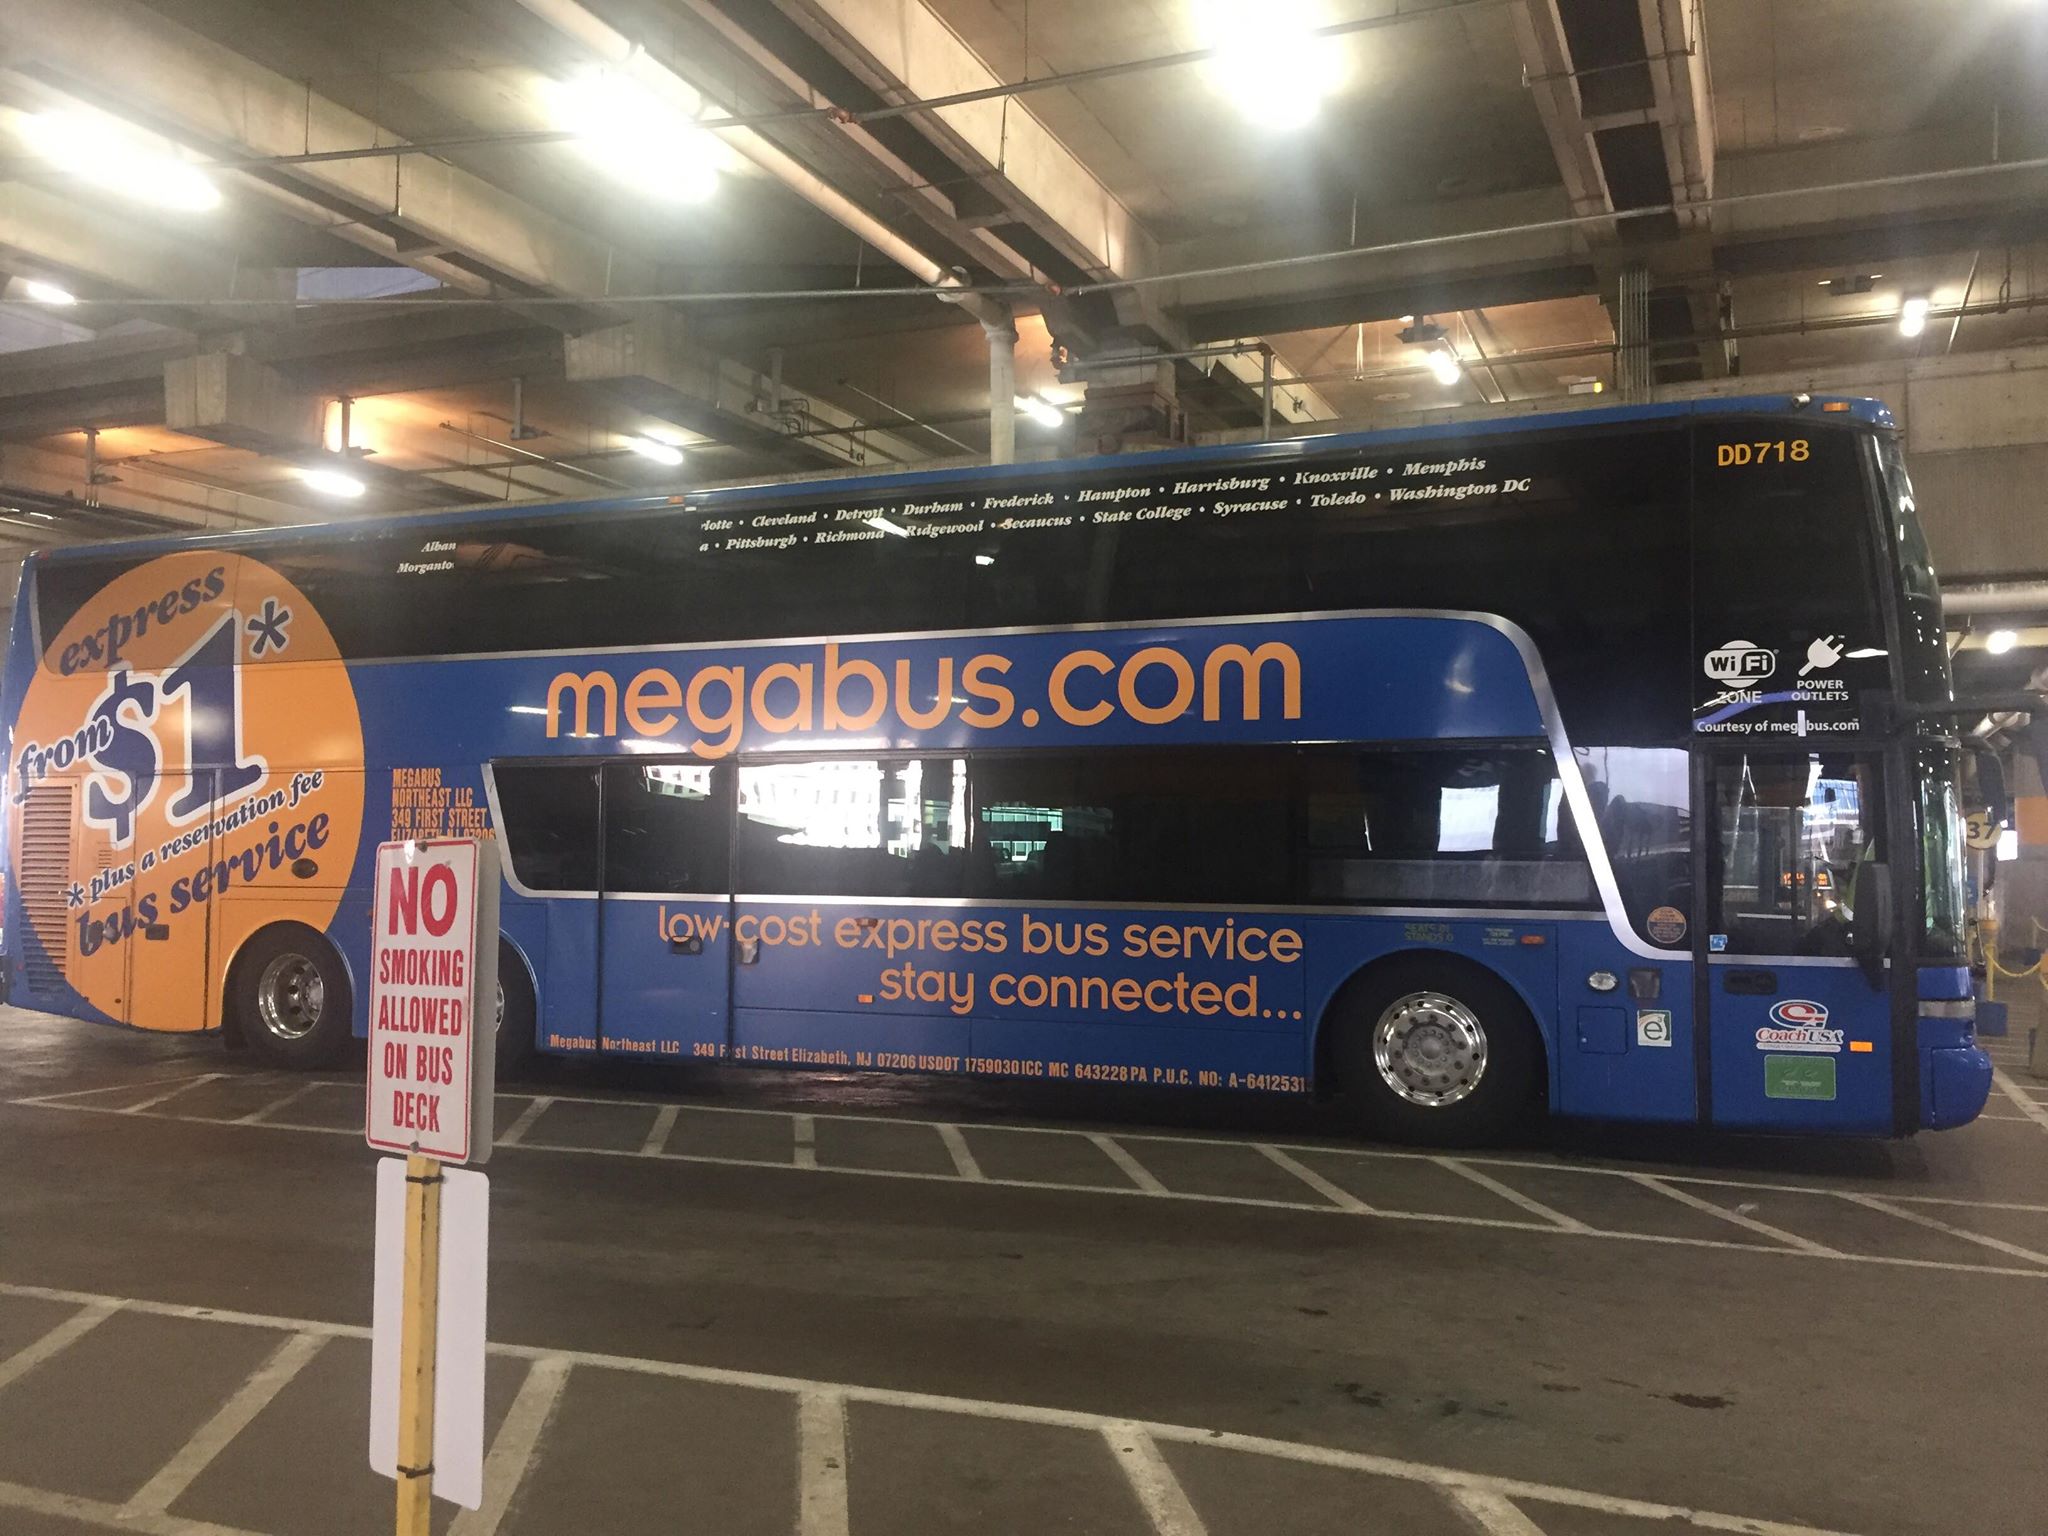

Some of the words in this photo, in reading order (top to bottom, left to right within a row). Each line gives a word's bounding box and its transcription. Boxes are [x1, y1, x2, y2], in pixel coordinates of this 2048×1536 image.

[1717, 439, 1810, 467] DD718
[725, 533, 798, 551] Pittsburgh
[814, 528, 886, 544] Richmond
[907, 519, 985, 539] Ridgewood
[1002, 514, 1073, 531] Secaucus
[1092, 508, 1134, 525] State
[1135, 503, 1192, 522] College
[1212, 496, 1289, 516] Syracuse
[1310, 491, 1367, 508] Toledo
[1389, 480, 1497, 505] Washington
[1501, 477, 1532, 494] DC
[752, 511, 818, 528] Cleveland
[835, 507, 885, 522] Detroit
[903, 502, 964, 516] Durham
[983, 493, 1055, 510] Frederick
[1077, 485, 1151, 503] Hampton
[1172, 475, 1271, 496] Harrisburg
[1293, 466, 1379, 485] Knoxville
[1402, 457, 1487, 476] Memphis
[397, 559, 455, 575] Morganto
[421, 540, 457, 553] Alban
[59, 565, 226, 677] express
[547, 642, 1302, 760] megabus.com
[1716, 690, 1763, 705] ZONE
[1791, 691, 1850, 702] OUTLETS
[1796, 680, 1844, 690] POWER
[1697, 720, 1752, 735] Courtesy
[1754, 720, 1769, 732] of
[1770, 720, 1860, 735] megbus.com
[15, 716, 114, 805] from
[392, 768, 442, 788] MEGABUS
[391, 808, 411, 828] 349
[415, 808, 445, 828] FIRST
[448, 807, 488, 828] STREET
[392, 788, 452, 808] NORTHEAST
[455, 788, 473, 808] LLC
[89, 865, 135, 903] plus
[141, 849, 156, 869] a
[160, 789, 285, 860] reservation
[288, 770, 324, 807] fee
[1966, 821, 1998, 840] 37
[76, 891, 159, 958] bus
[170, 813, 330, 914] service
[388, 863, 458, 937] NO
[834, 914, 1009, 959] express
[1022, 914, 1110, 957] bus
[1121, 918, 1303, 963] service
[379, 948, 464, 988] SMOKING
[879, 961, 976, 1016] stay
[989, 971, 1303, 1021] connected...
[378, 995, 463, 1037] ALLOWED
[384, 1041, 408, 1080] ON
[416, 1045, 453, 1086] BUS
[549, 1034, 598, 1051] Megabus
[602, 1036, 657, 1053] Northeast
[660, 1039, 680, 1054] LLC
[693, 1043, 715, 1057] 349
[719, 1044, 747, 1059] Fst
[751, 1046, 788, 1062] Street
[856, 1052, 872, 1067] NJ
[877, 1053, 917, 1069] 07206
[919, 1055, 960, 1072] USDOT
[1048, 1061, 1069, 1078] MC
[1074, 1063, 1128, 1082] 643228
[1129, 1066, 1148, 1083] PA
[1198, 1070, 1223, 1088] NO:
[392, 1089, 441, 1134] DECK
